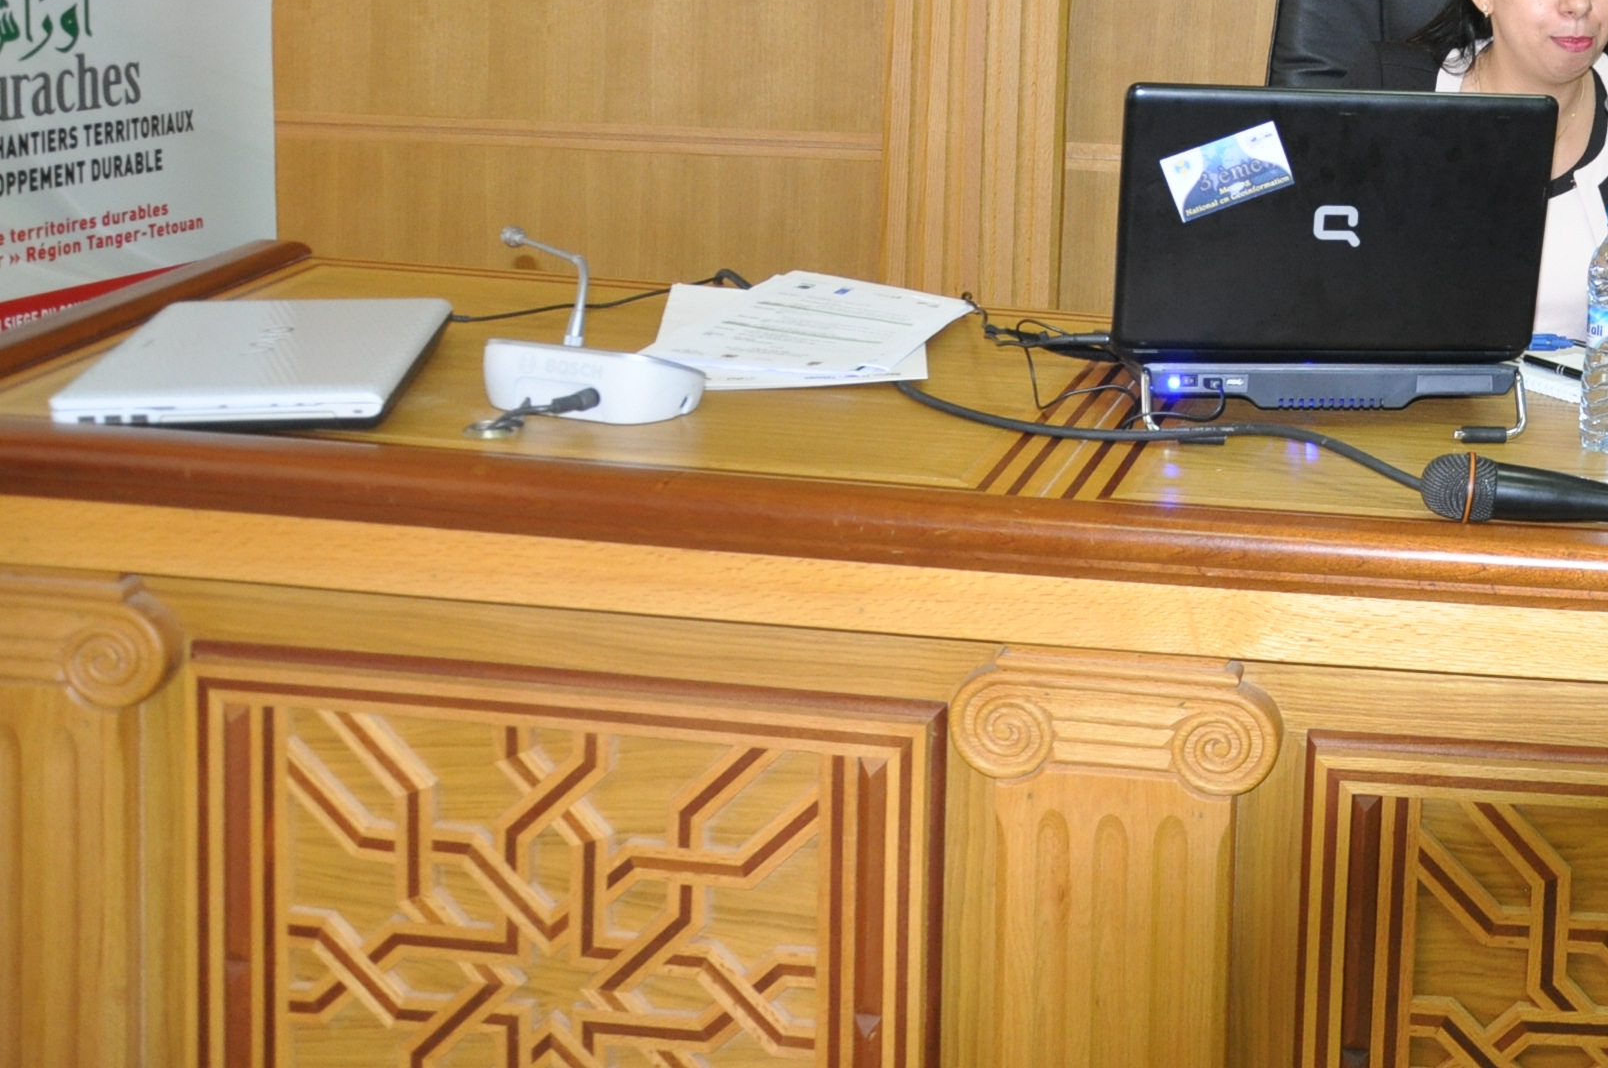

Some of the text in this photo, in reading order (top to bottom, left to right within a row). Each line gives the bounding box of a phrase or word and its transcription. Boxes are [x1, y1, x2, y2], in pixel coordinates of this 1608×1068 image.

[83, 109, 195, 148] TERRITORIAUX
[91, 148, 164, 182] DURABLE
[10, 217, 97, 243] territoires
[102, 204, 169, 226] durables
[1185, 199, 1219, 217] National
[26, 241, 82, 262] Région
[86, 216, 204, 250] Tanger-Tetouan
[545, 358, 603, 380] BOSCH
